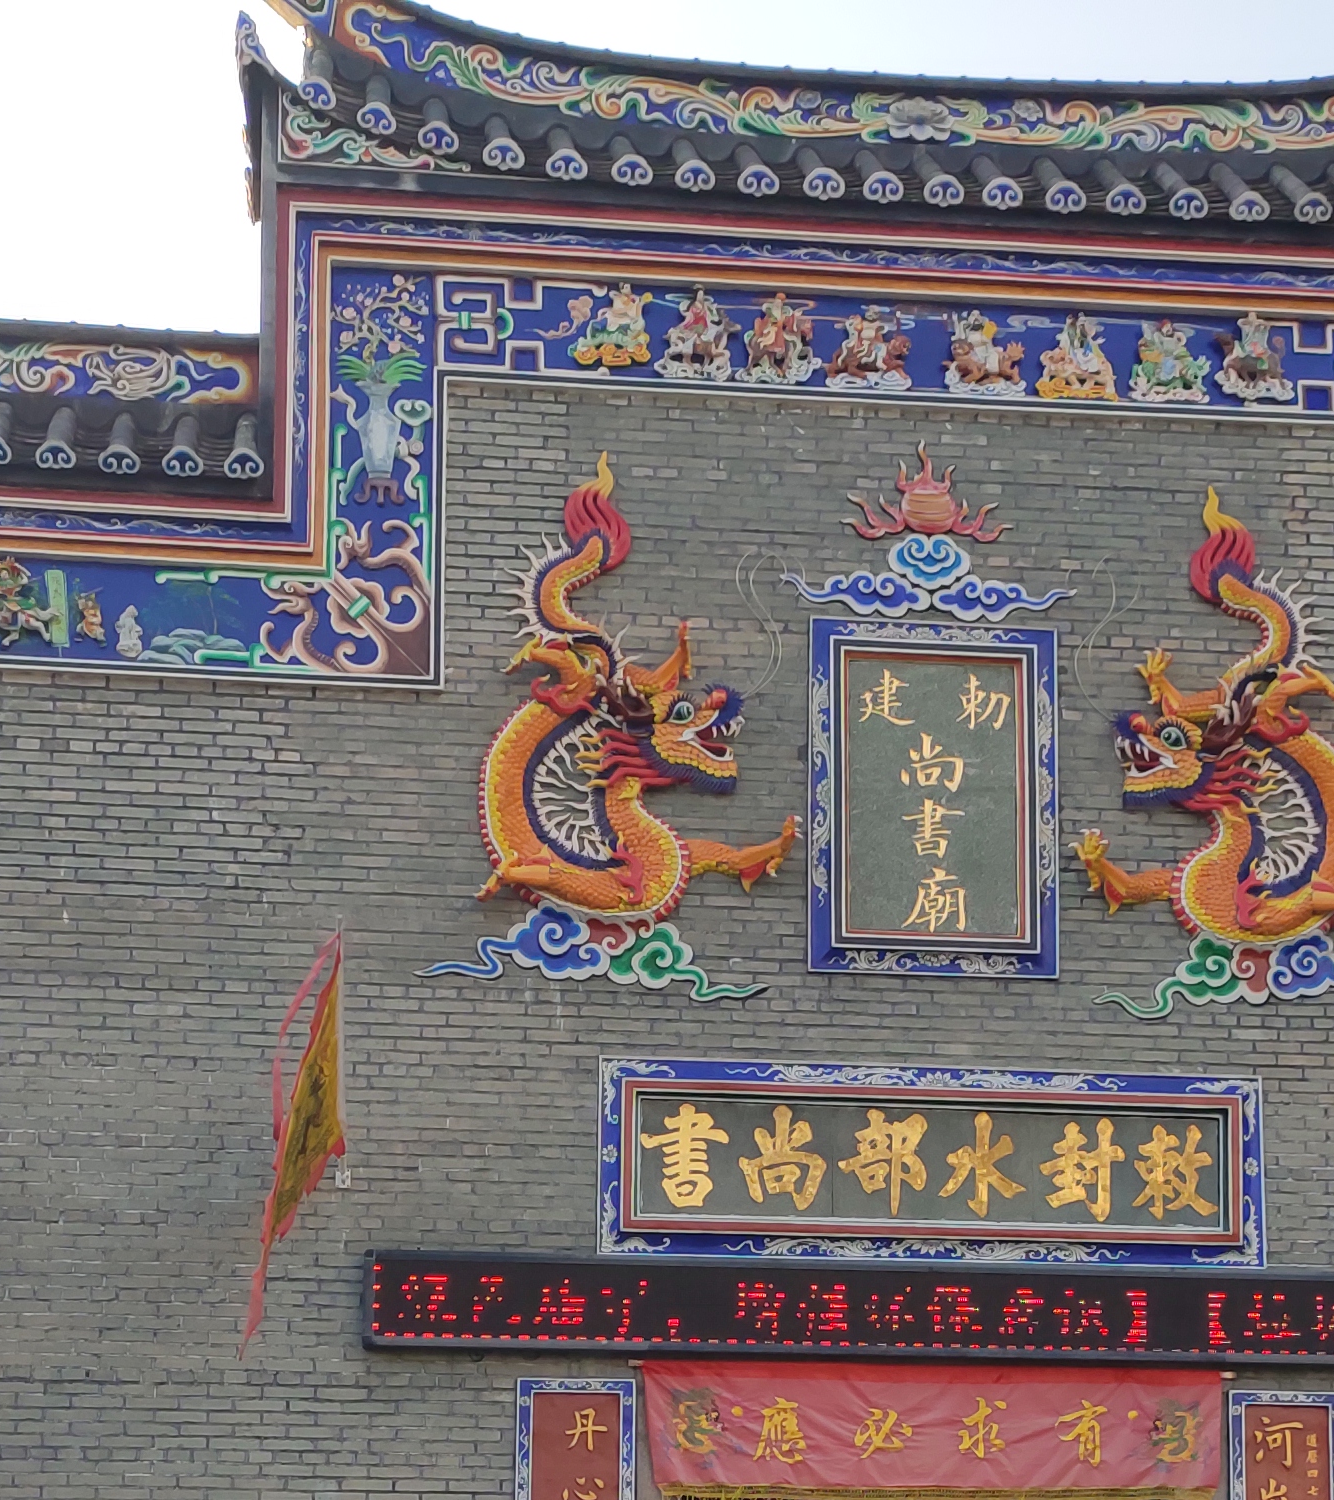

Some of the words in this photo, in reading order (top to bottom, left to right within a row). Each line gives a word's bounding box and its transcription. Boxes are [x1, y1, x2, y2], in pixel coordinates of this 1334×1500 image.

[897, 731, 967, 934] 尚書廟
[753, 1396, 1107, 1467] 有求必應
